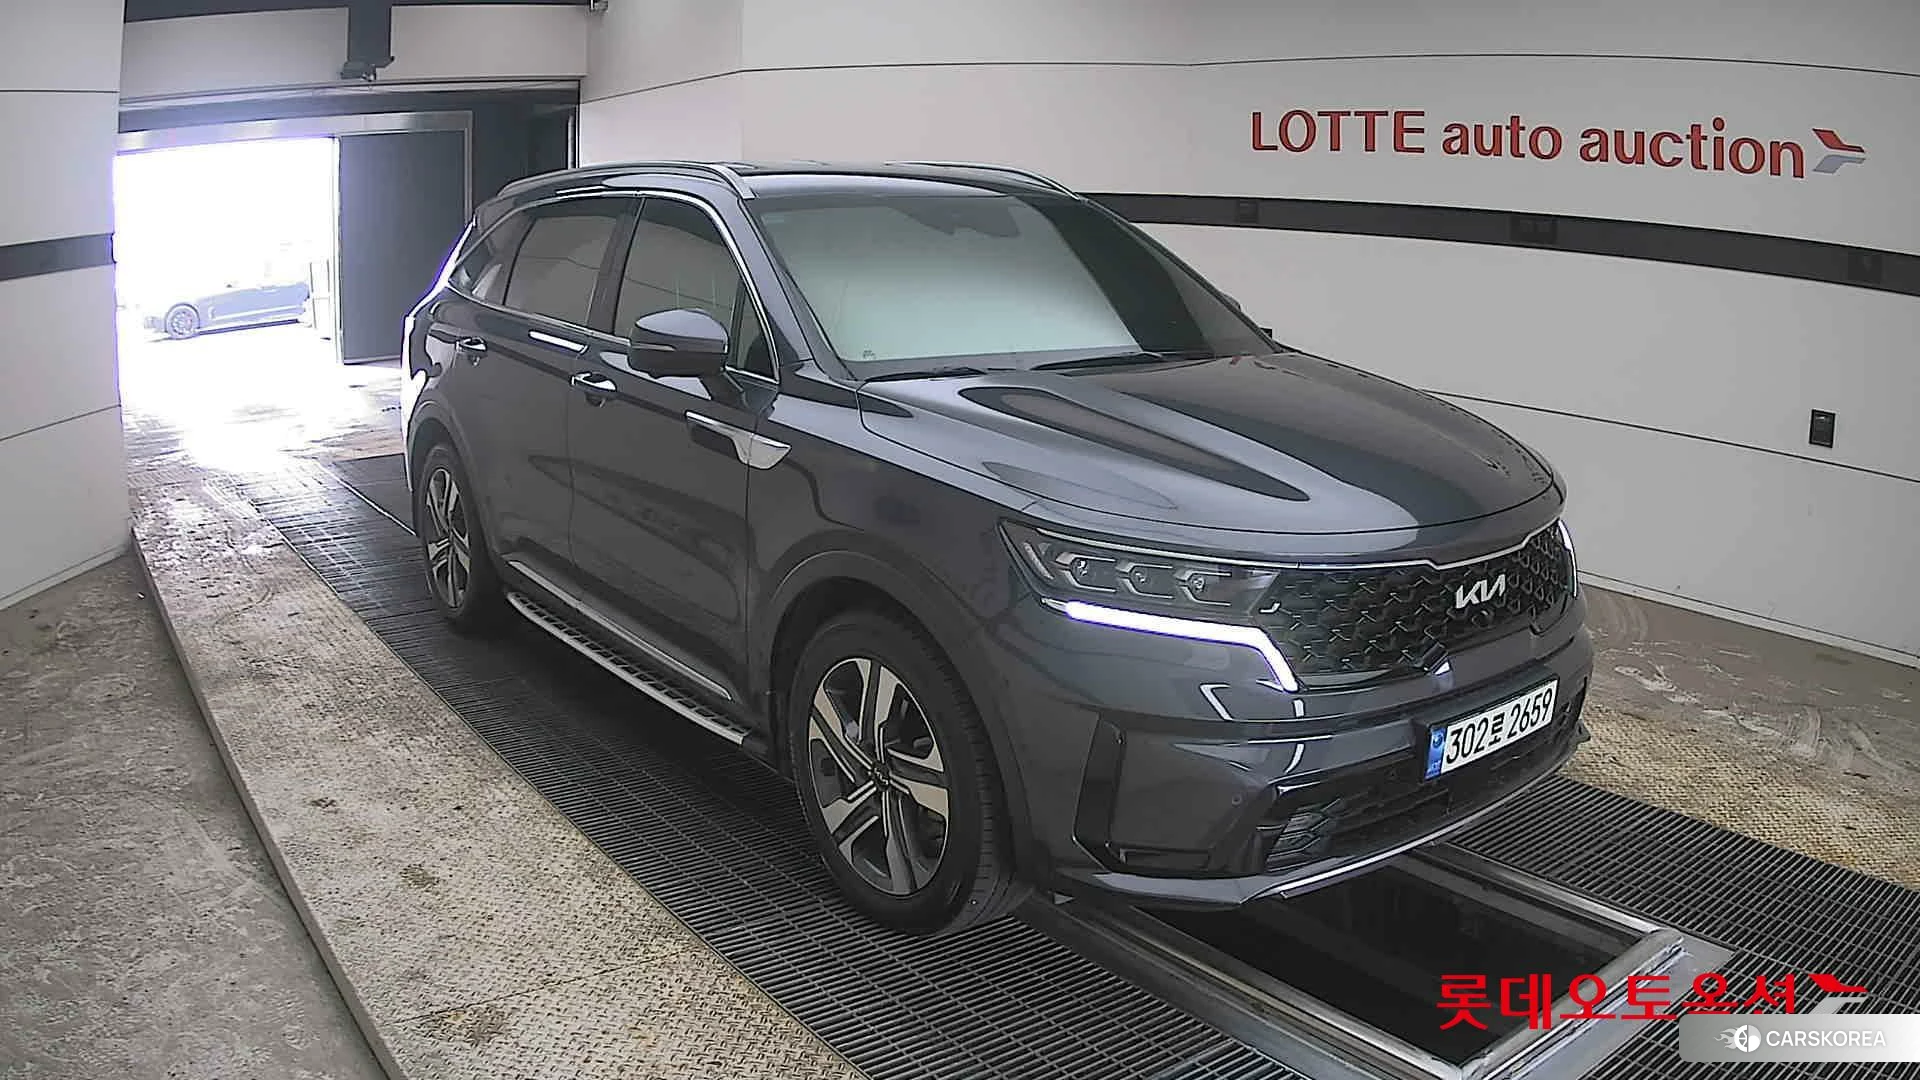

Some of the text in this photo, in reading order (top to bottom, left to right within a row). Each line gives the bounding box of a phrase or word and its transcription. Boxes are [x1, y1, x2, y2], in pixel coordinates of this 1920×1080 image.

[1251, 110, 1805, 179] LOTTE auto auction
[1456, 573, 1506, 609] KIA
[1446, 688, 1553, 764] 302로 2659
